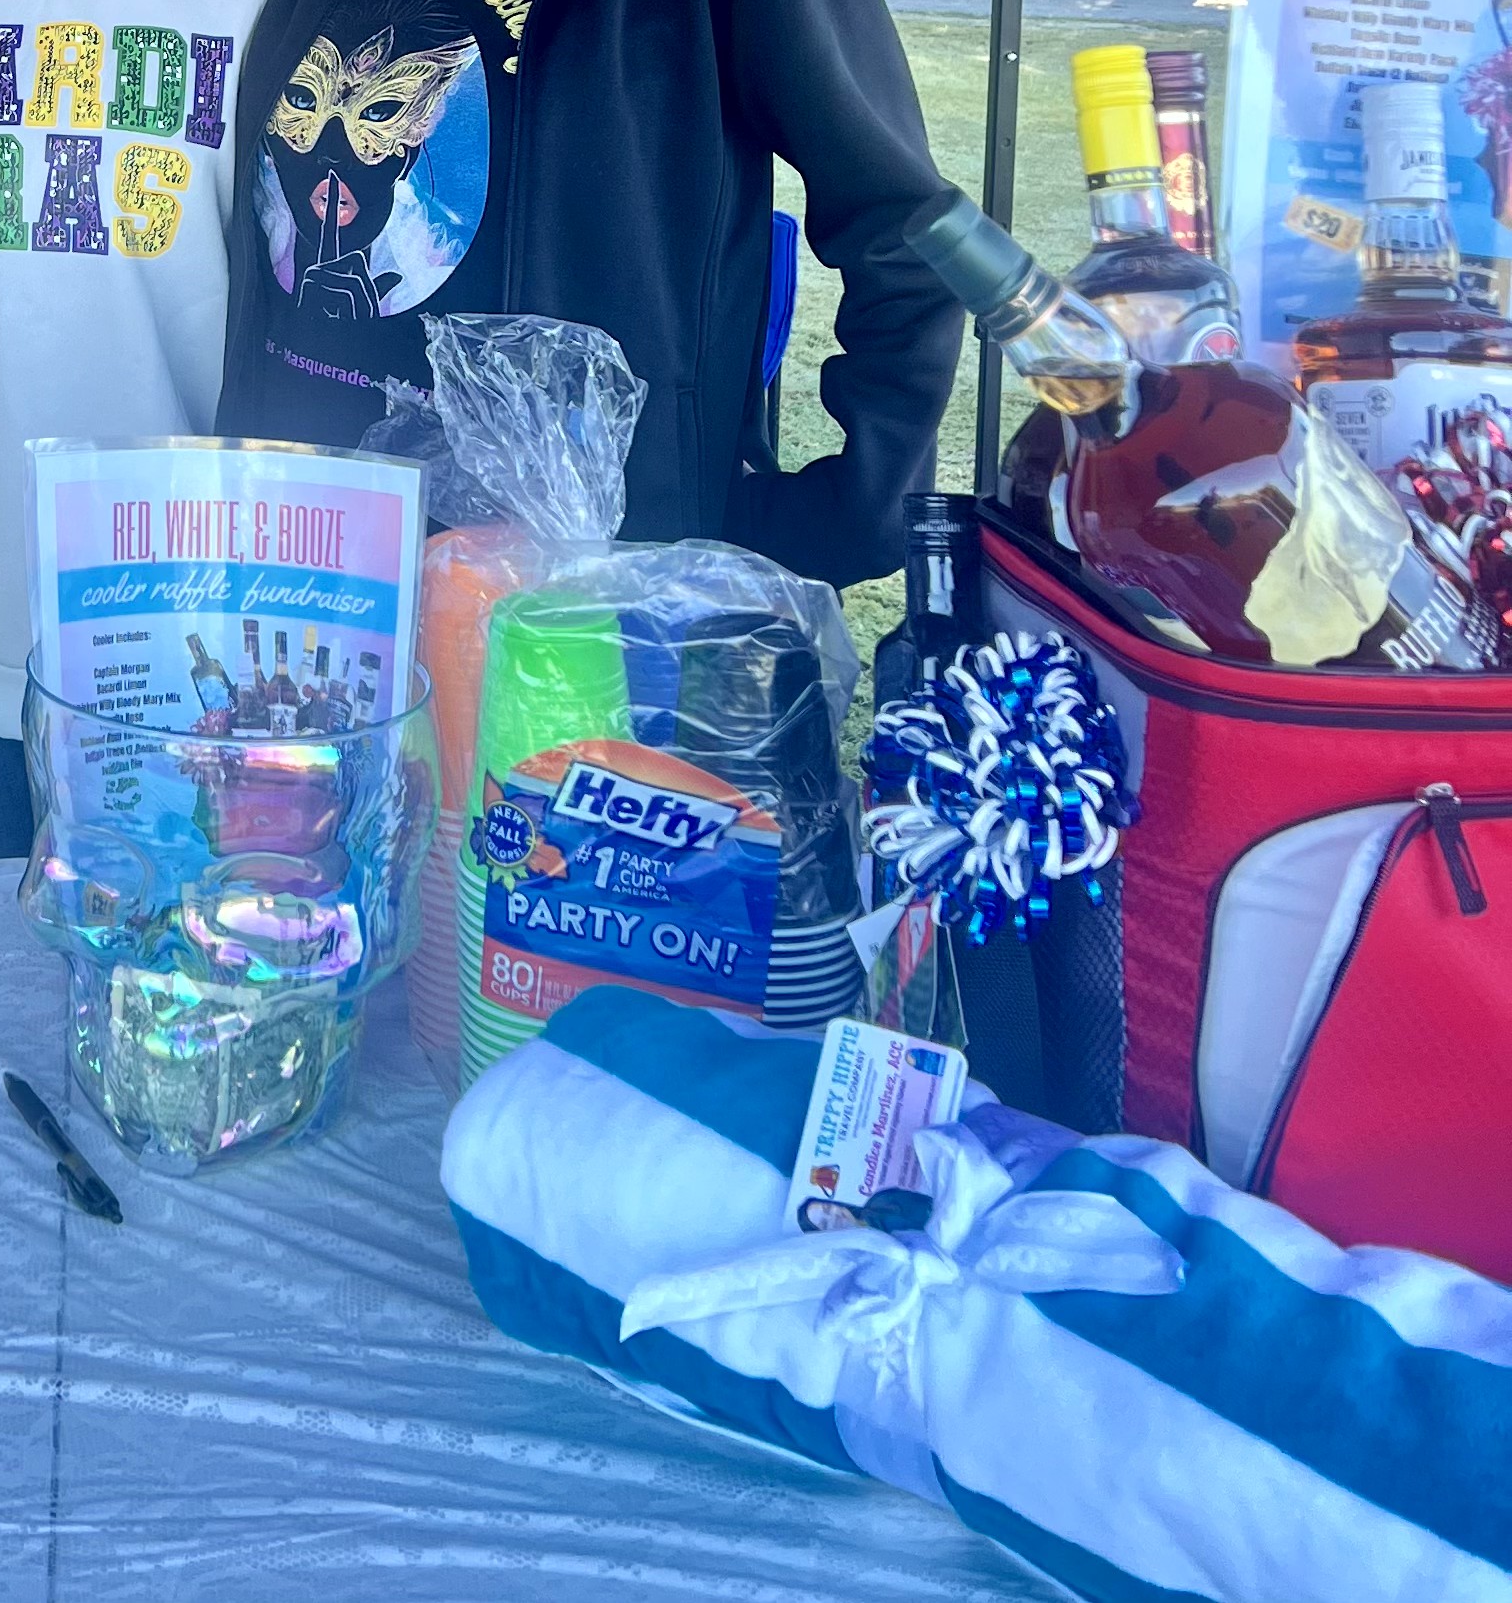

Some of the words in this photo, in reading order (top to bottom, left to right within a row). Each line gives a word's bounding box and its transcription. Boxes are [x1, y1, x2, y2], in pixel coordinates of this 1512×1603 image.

[113, 500, 157, 564] RED,
[165, 500, 245, 565] WHITE,
[254, 500, 270, 562] &
[278, 503, 346, 570] BOOZE
[81, 570, 147, 607] cooler
[149, 569, 232, 611] raffle
[240, 571, 376, 615] fundraiser
[143, 694, 164, 706] Mary
[165, 692, 182, 704] Mix
[493, 805, 526, 826] NEW
[565, 769, 724, 849] Hefty
[489, 821, 522, 845] FALL
[618, 850, 675, 878] PARTY
[612, 884, 671, 901] AMERICA
[620, 869, 656, 889] CUP
[506, 892, 644, 947] PARTY
[651, 923, 740, 976] ON!
[491, 951, 535, 992] 80
[490, 980, 531, 1008] CUPS
[814, 1089, 844, 1158] TRIPPY
[831, 1025, 860, 1087] HIPPIE
